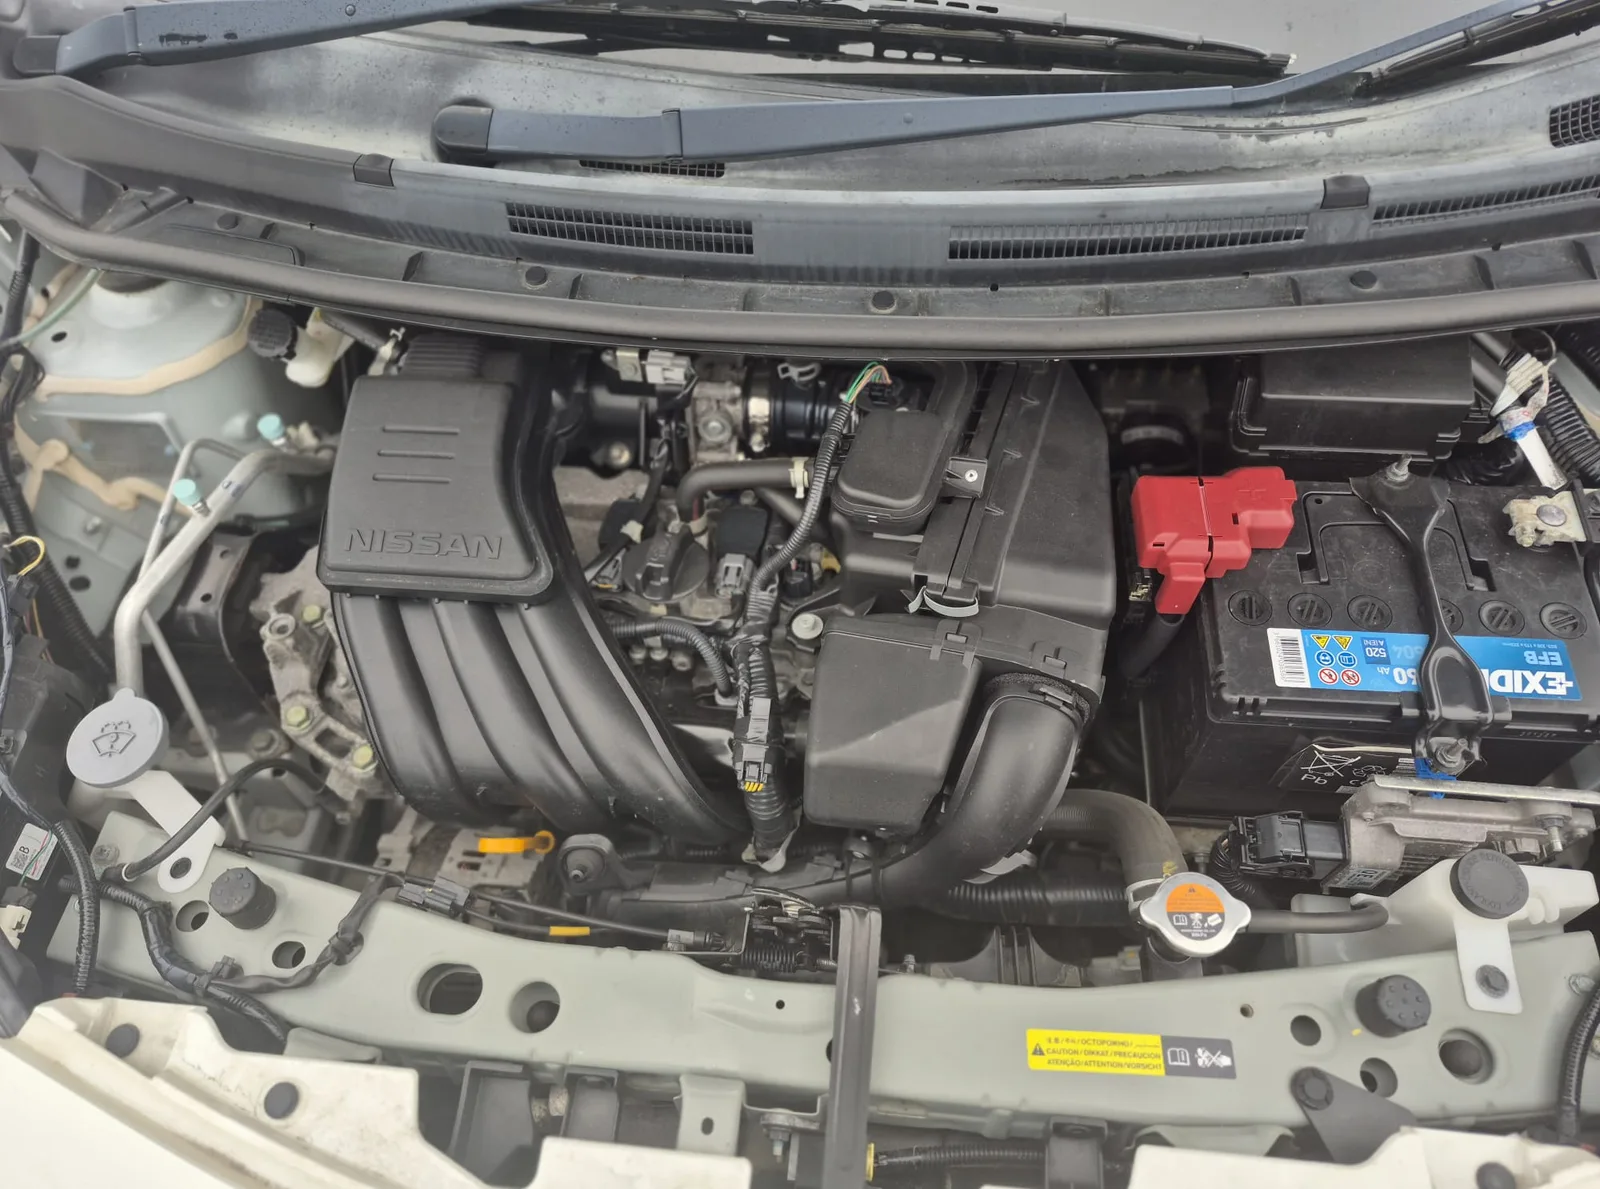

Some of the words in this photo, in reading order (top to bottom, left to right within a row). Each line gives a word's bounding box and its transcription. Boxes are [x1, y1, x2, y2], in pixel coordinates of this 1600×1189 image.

[345, 528, 503, 560] NISSAN
[1366, 647, 1387, 658] 520
[1523, 651, 1563, 666] EFB
[1377, 667, 1390, 675] Ah
[1301, 774, 1328, 785] Pb
[19, 845, 30, 855] B
[1046, 1047, 1079, 1056] CAUTION
